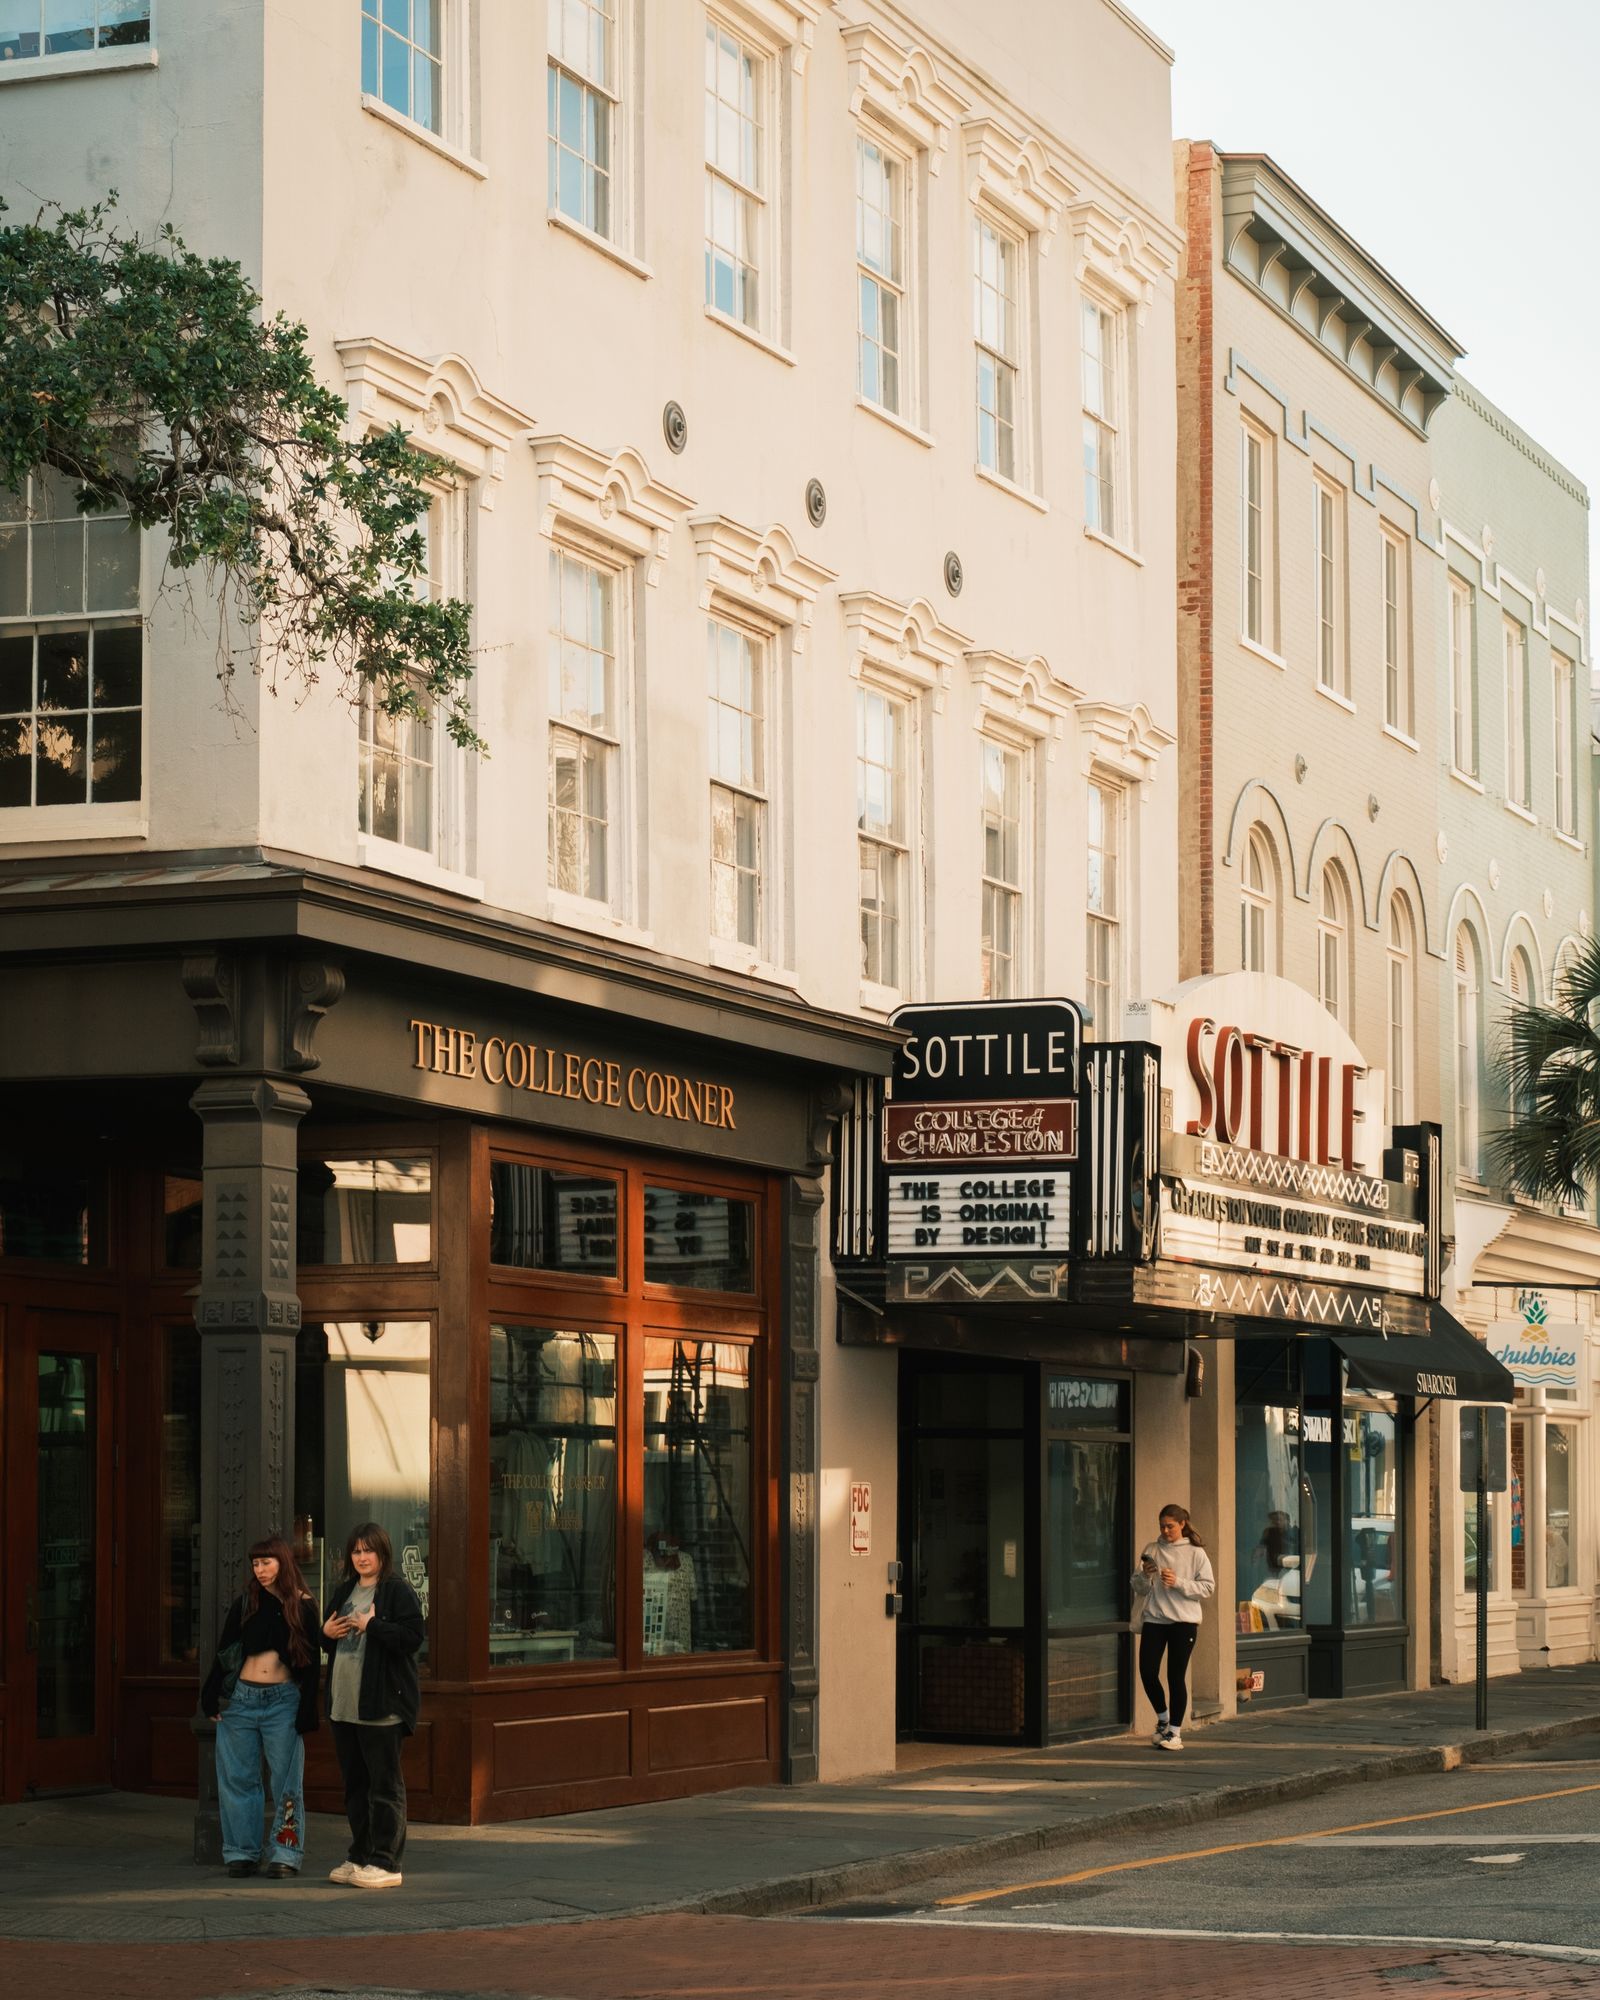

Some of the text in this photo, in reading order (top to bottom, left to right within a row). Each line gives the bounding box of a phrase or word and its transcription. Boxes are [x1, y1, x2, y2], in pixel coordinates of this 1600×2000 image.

[902, 1031, 1066, 1079] SOTTILE
[410, 1019, 736, 1129] THE COLLEGE CORNER
[1187, 1018, 1367, 1172] SOTTILE
[914, 1108, 1024, 1131] COLLEGE
[897, 1130, 1064, 1154] CHARLESTON
[901, 1179, 1056, 1199] THE COLLEGE
[921, 1203, 1055, 1222] IS ORIGINAL
[1171, 1186, 1247, 1224] CHARLESTON
[1247, 1201, 1281, 1231] YOUTH
[1284, 1208, 1330, 1238] COMPANY
[1332, 1216, 1365, 1245] SPRING
[915, 1222, 1047, 1249] BY DESIGN!
[1494, 1344, 1576, 1366] chubbies
[1416, 1372, 1457, 1396] SWAROVSKI
[852, 1487, 869, 1513] FDC
